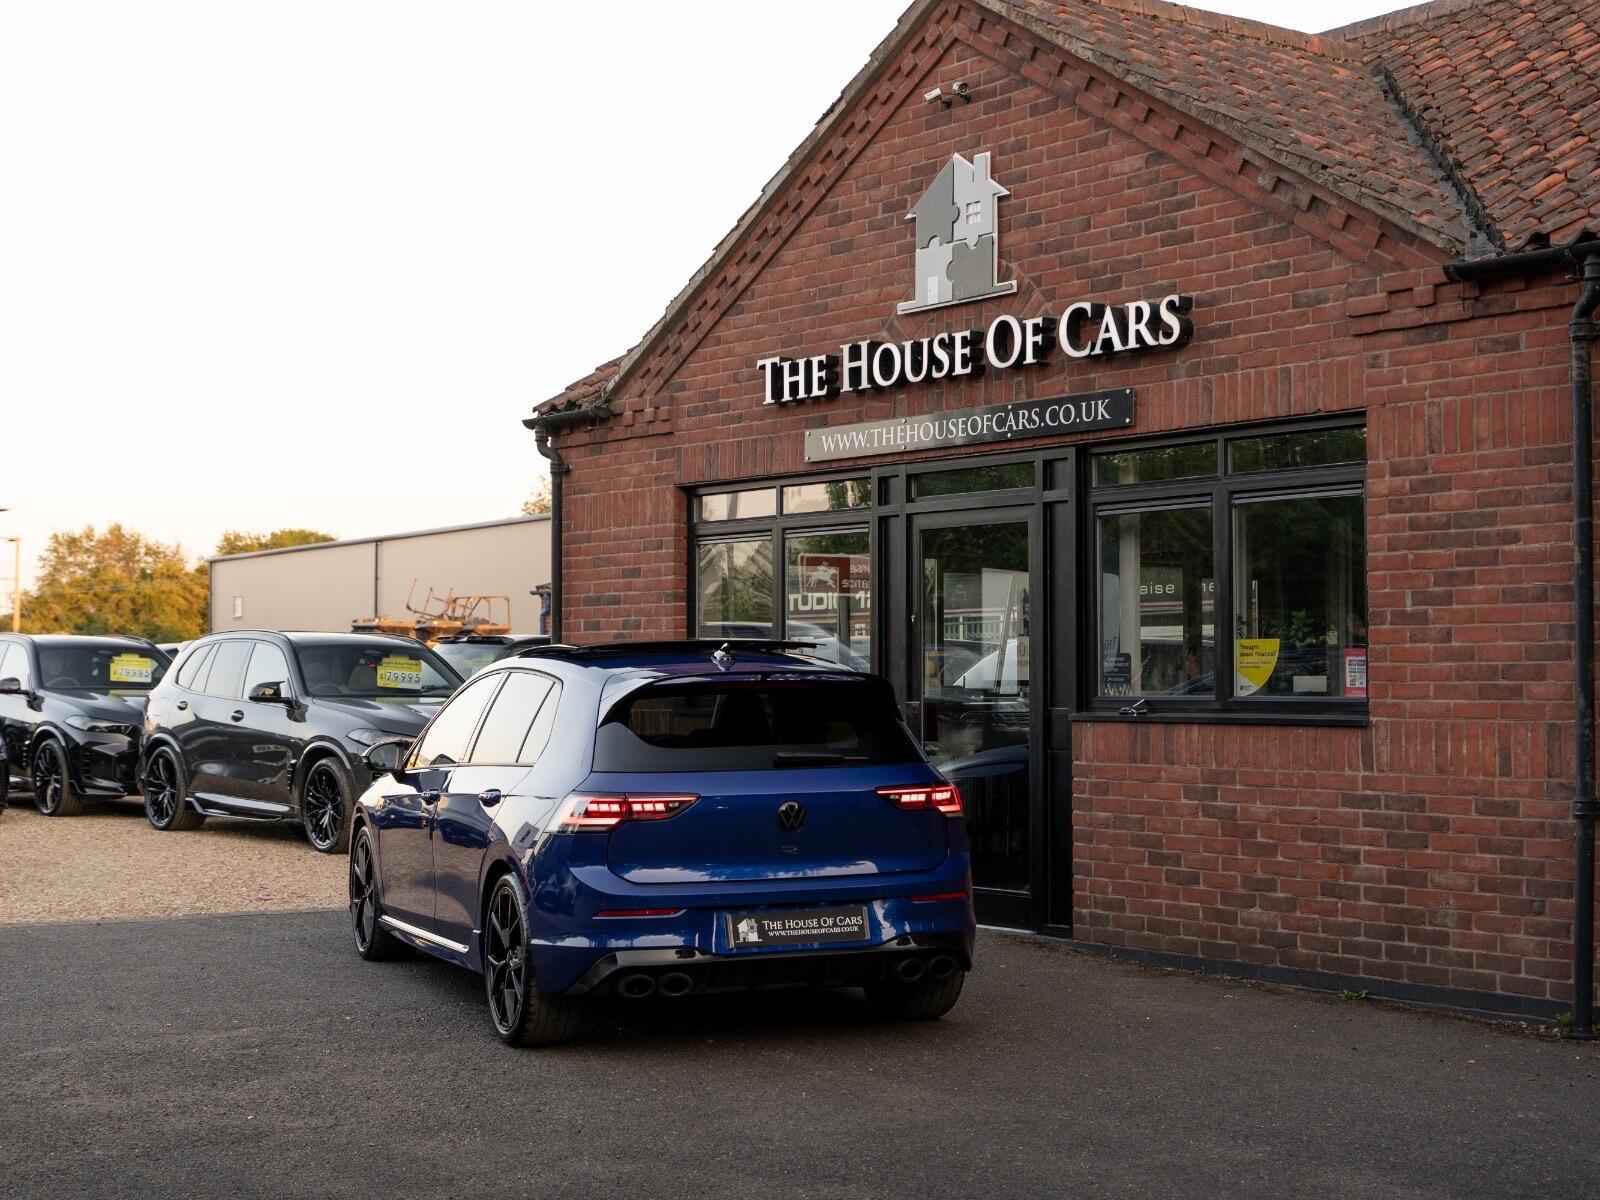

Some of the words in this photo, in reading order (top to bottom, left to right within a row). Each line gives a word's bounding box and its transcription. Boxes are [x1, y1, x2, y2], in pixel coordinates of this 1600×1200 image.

[757, 355, 829, 405] THE
[839, 330, 972, 393] HOUSE
[985, 314, 1044, 369] OF
[1059, 294, 1182, 358] CARS
[821, 398, 1112, 454] WWW.THEHOUSEOFCARS.CO.UK
[762, 920, 783, 930] THE
[785, 918, 819, 929] HOUSE
[820, 916, 834, 927] OF
[836, 915, 863, 926] CARS
